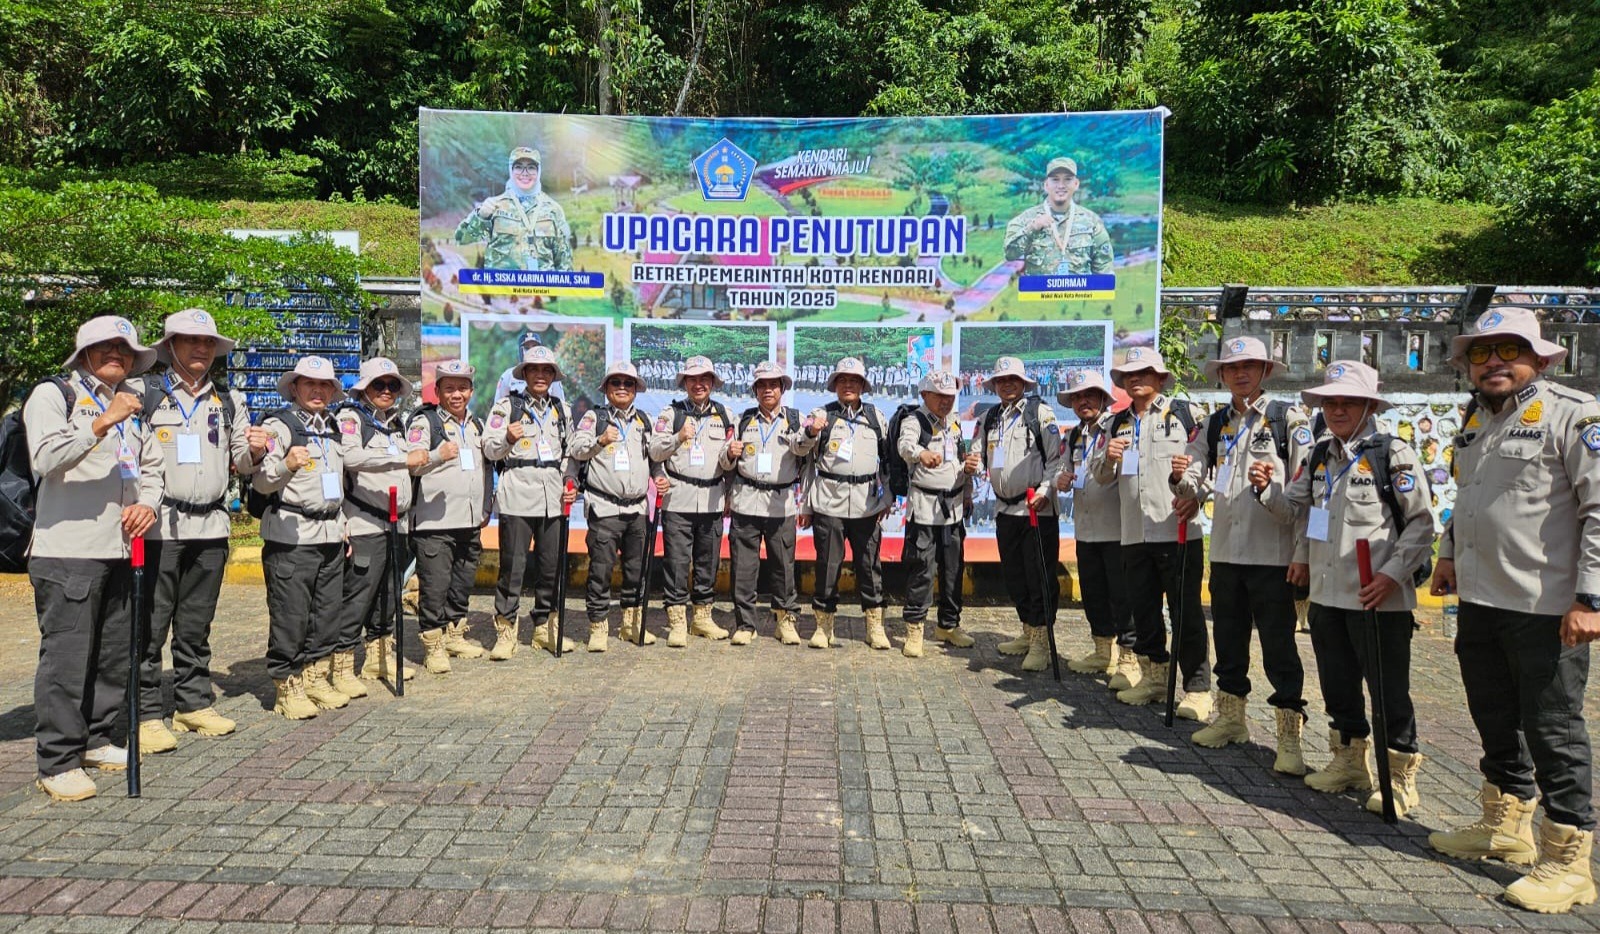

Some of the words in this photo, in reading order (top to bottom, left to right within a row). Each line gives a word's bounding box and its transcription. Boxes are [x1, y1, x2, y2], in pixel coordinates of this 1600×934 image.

[797, 148, 847, 163] KENDARI
[774, 163, 828, 179] SEMAKIN
[830, 155, 871, 175] MAJU!
[605, 215, 759, 253] UPACARA
[771, 218, 964, 254] PENUTUPAN
[472, 272, 481, 281] dr.
[483, 273, 493, 284] Hj.
[495, 273, 516, 282] SISKA
[517, 273, 545, 283] KARINA
[546, 274, 572, 285] IMRAN,
[573, 275, 590, 285] SKM
[634, 266, 694, 282] RETRET
[699, 267, 804, 284] PEMERINTAH
[810, 268, 854, 284] KOTA
[859, 268, 934, 284] KENDARI
[1046, 278, 1087, 288] SUDIRMAN
[729, 291, 785, 306] TAHUN
[790, 292, 835, 307] 2025
[1156, 421, 1178, 431] CAAT
[1508, 428, 1543, 440] KABAG
